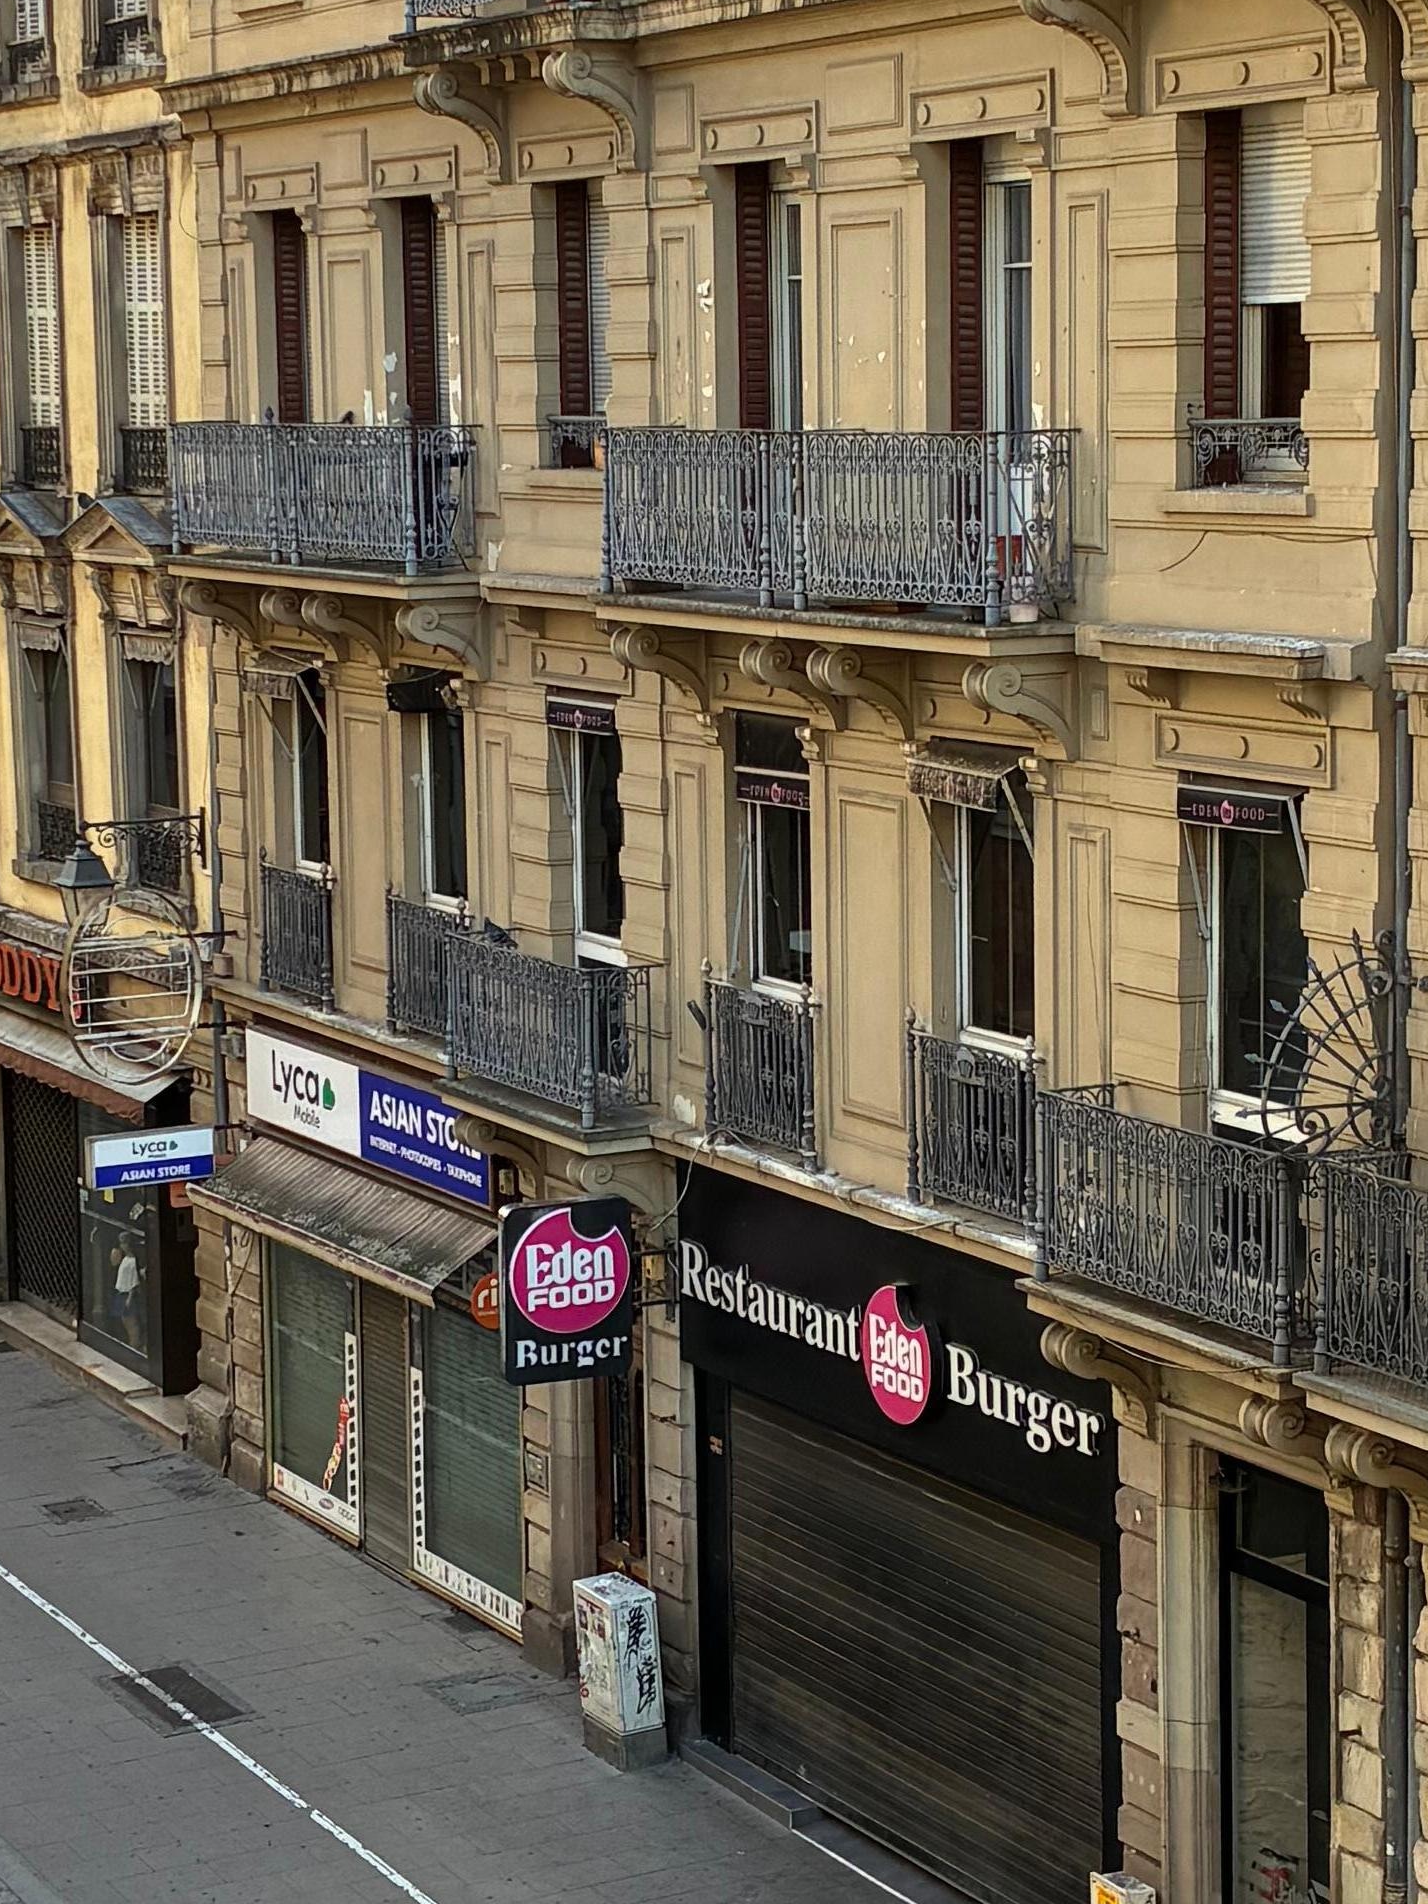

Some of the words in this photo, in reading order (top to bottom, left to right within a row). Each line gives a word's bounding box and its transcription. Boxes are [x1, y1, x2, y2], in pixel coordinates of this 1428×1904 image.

[272, 1049, 321, 1106] Lyca
[293, 1103, 321, 1129] Mobile
[370, 1090, 422, 1139] ASIAN
[132, 1140, 167, 1157] Lyca
[120, 1168, 156, 1182] ASIAN
[157, 1163, 191, 1178] STORE
[525, 1240, 615, 1289] Eden
[477, 1278, 498, 1309] ri
[527, 1279, 616, 1313] FOOD
[679, 1238, 862, 1363] Restaurant
[515, 1336, 629, 1369] Burger
[869, 1313, 925, 1379] Eden
[870, 1362, 925, 1404] FOOD
[945, 1341, 1105, 1457] Burger
